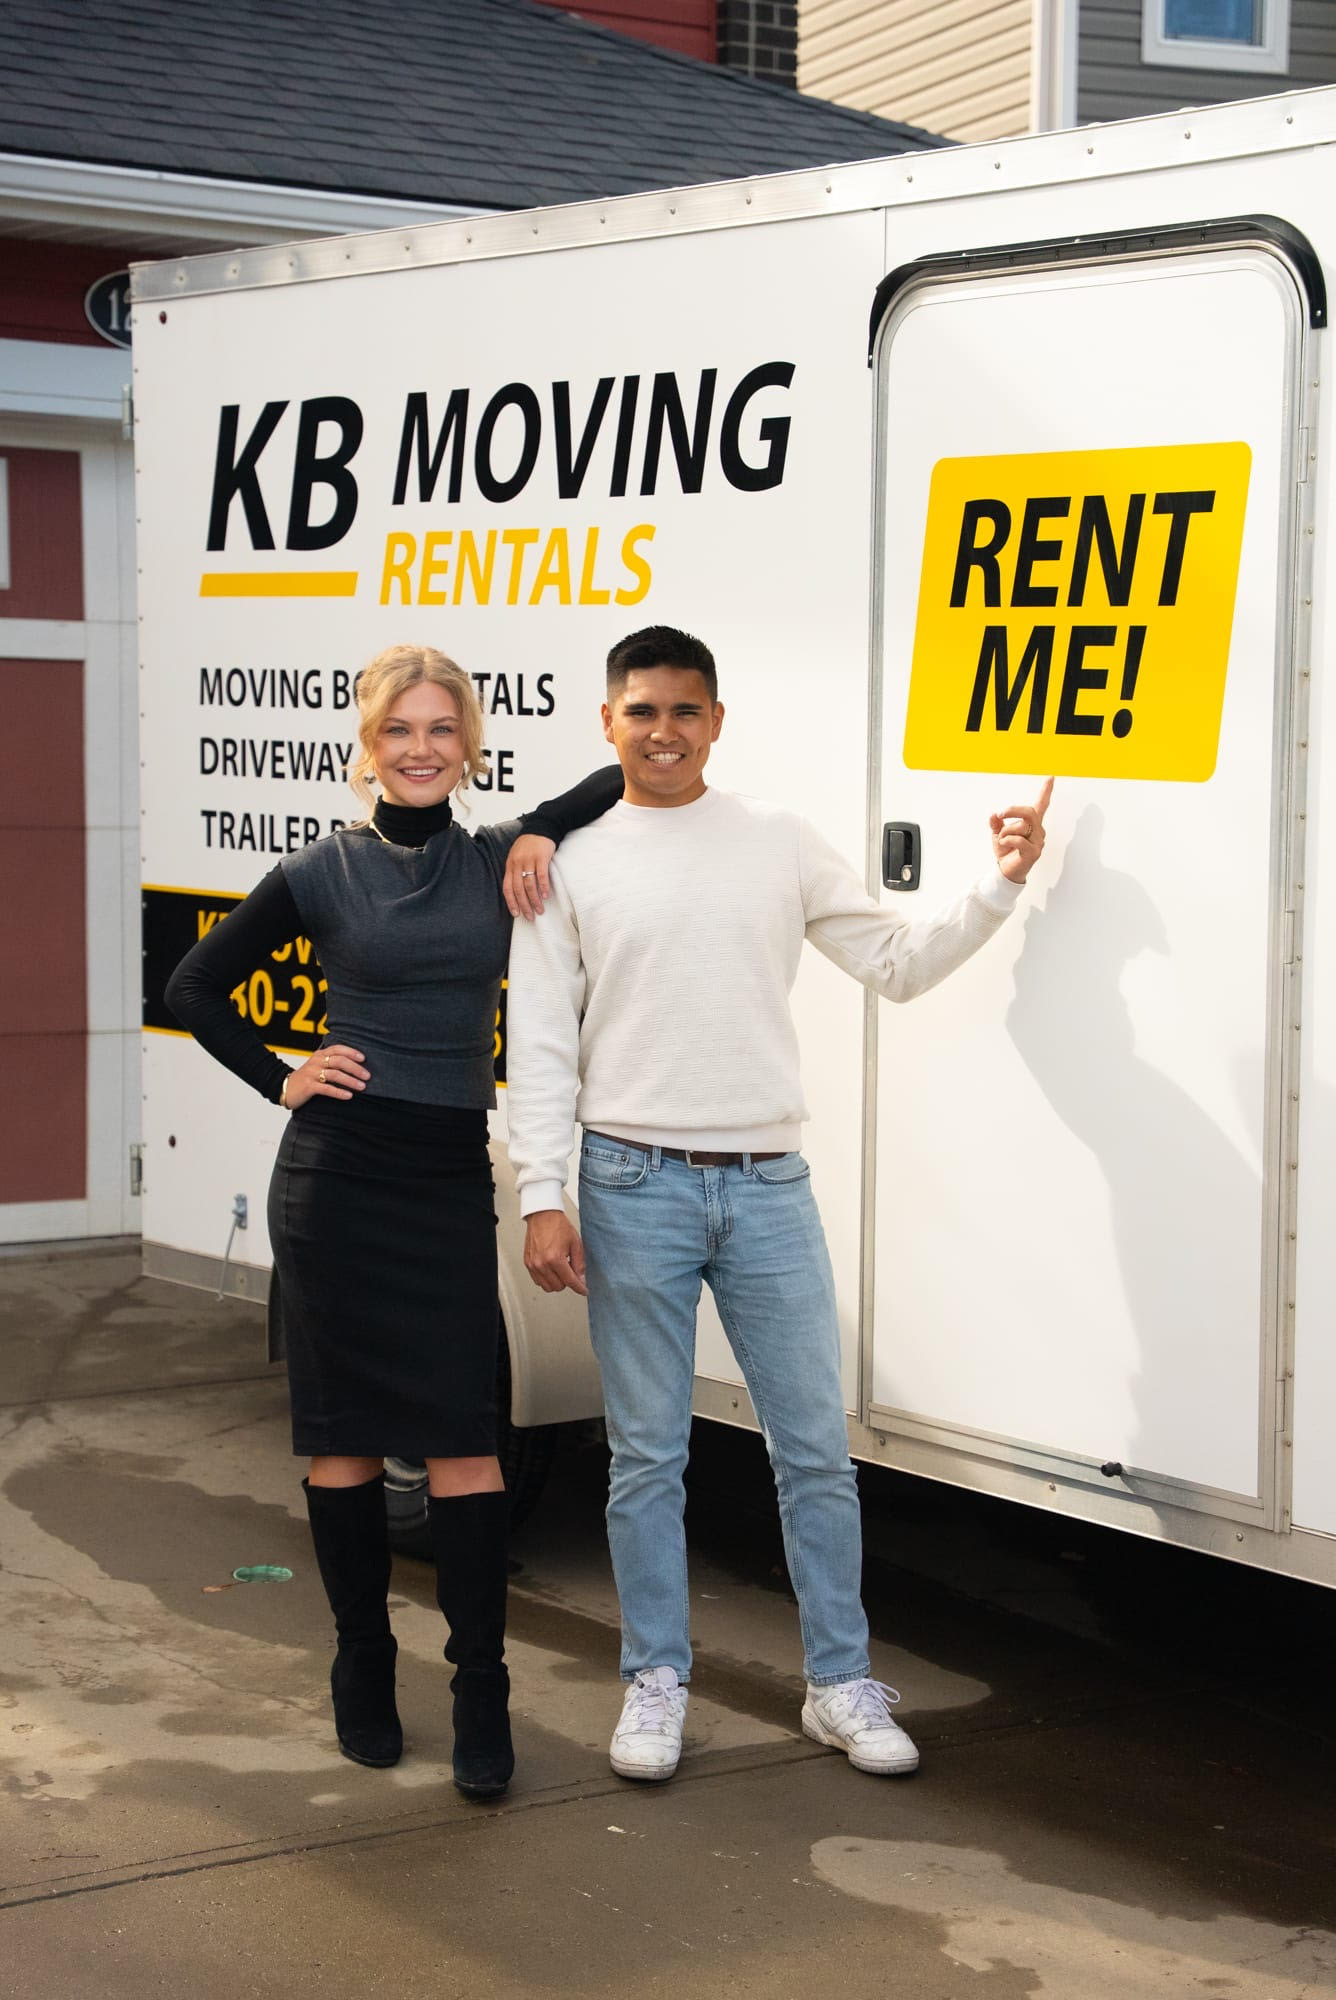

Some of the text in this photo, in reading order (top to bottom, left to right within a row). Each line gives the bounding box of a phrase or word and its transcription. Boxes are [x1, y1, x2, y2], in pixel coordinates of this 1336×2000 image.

[206, 361, 796, 552] KB MOVING
[379, 524, 656, 606] RENTALS
[949, 490, 1216, 608] RENT
[201, 667, 322, 709] MOVING
[471, 672, 555, 717] TALS
[965, 625, 1147, 739] ME!
[201, 737, 353, 782] DRIVEWAY
